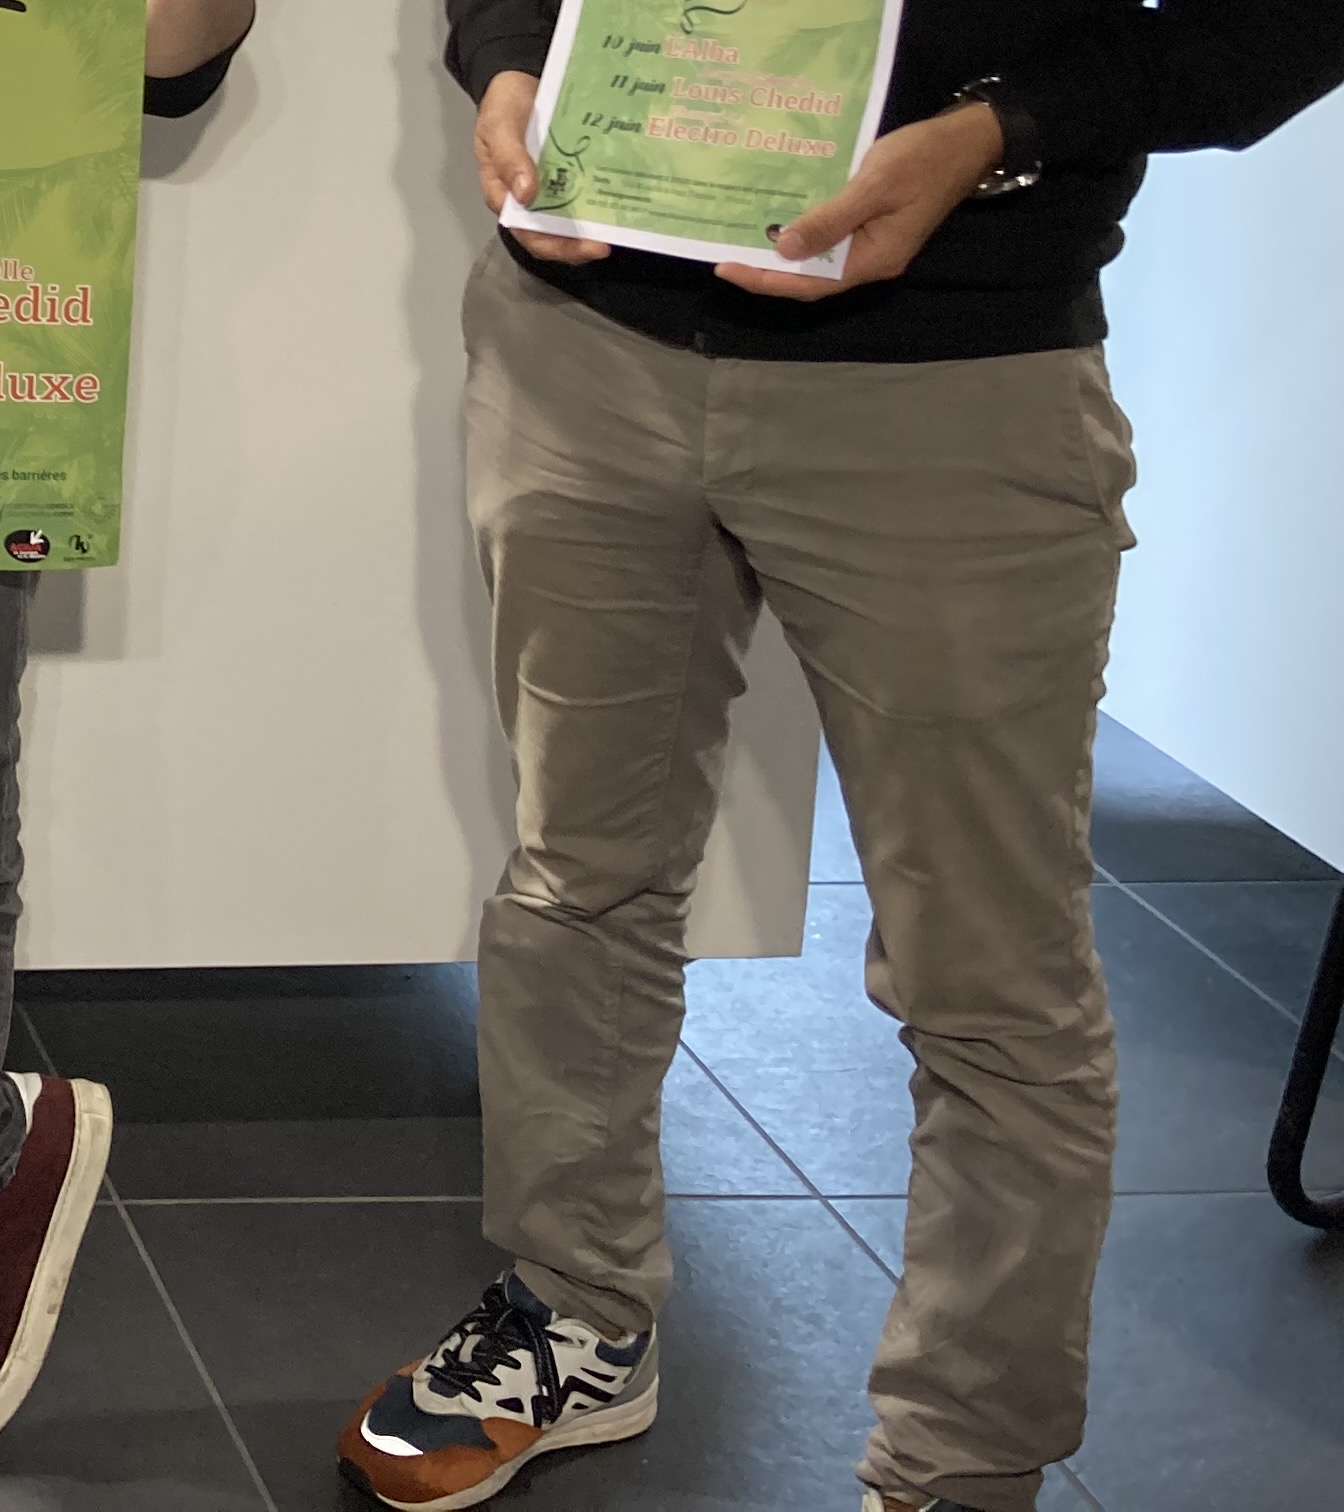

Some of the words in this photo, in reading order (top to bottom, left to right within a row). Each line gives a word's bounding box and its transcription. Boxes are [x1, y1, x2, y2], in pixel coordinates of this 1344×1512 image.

[749, 87, 843, 117] Chedid
[645, 115, 738, 147] Electro
[743, 127, 837, 158] Deluxe
